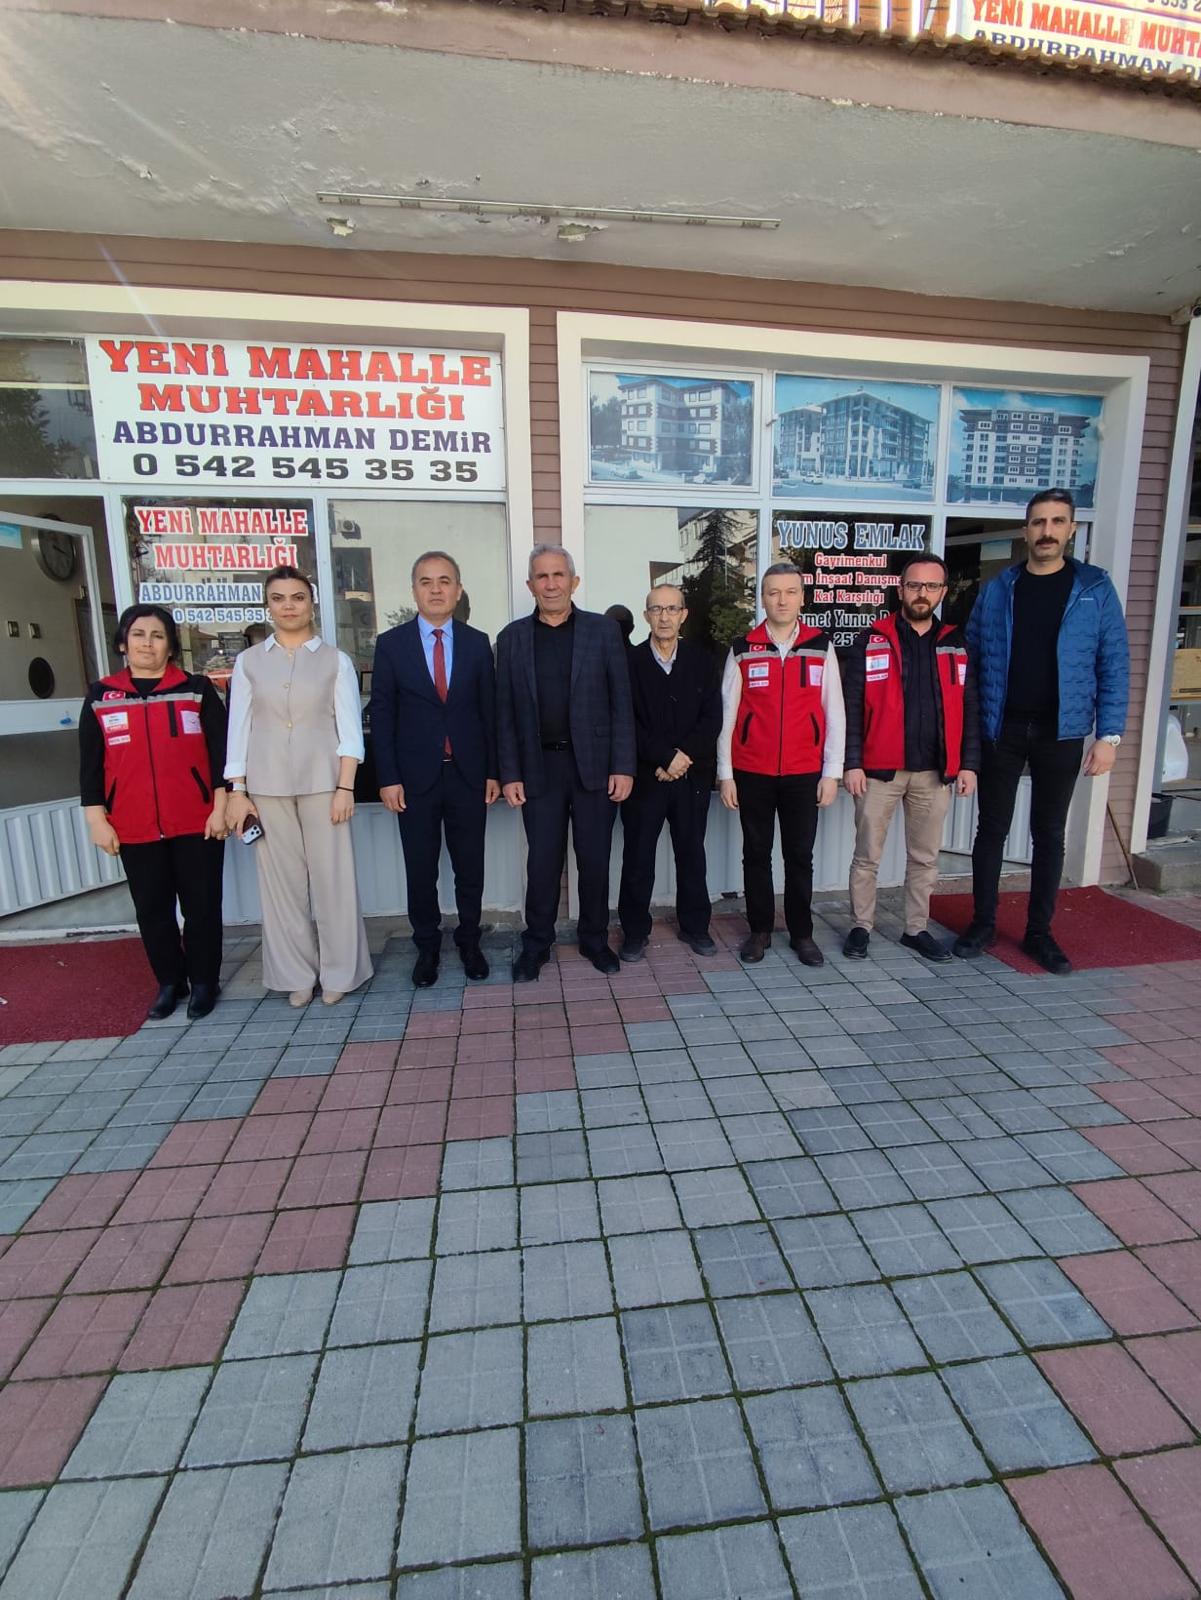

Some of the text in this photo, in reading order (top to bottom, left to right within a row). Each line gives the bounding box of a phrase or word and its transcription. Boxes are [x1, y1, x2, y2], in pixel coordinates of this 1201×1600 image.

[1030, 2, 1134, 45] MAHALLE
[246, 346, 491, 386] MAHALLE
[137, 383, 465, 420] MUHTARLIĞI
[113, 420, 375, 449] ABDURRAHMAN
[133, 453, 478, 482] 0 542 545 35 35
[198, 509, 308, 535] MAHALLE
[777, 521, 925, 550] YUNUS EMLAK
[154, 537, 298, 570] MUHTARLIĞI
[815, 552, 887, 569] Gayrimenkul
[816, 569, 853, 588] İnşaat
[140, 583, 263, 603] ABDURRAHMAN
[813, 589, 885, 607] Kat Karşılığı
[174, 608, 184, 622] 0
[187, 608, 214, 622] 542
[216, 608, 243, 622] 545
[245, 608, 264, 622] 35
[834, 609, 876, 628] Yunus
